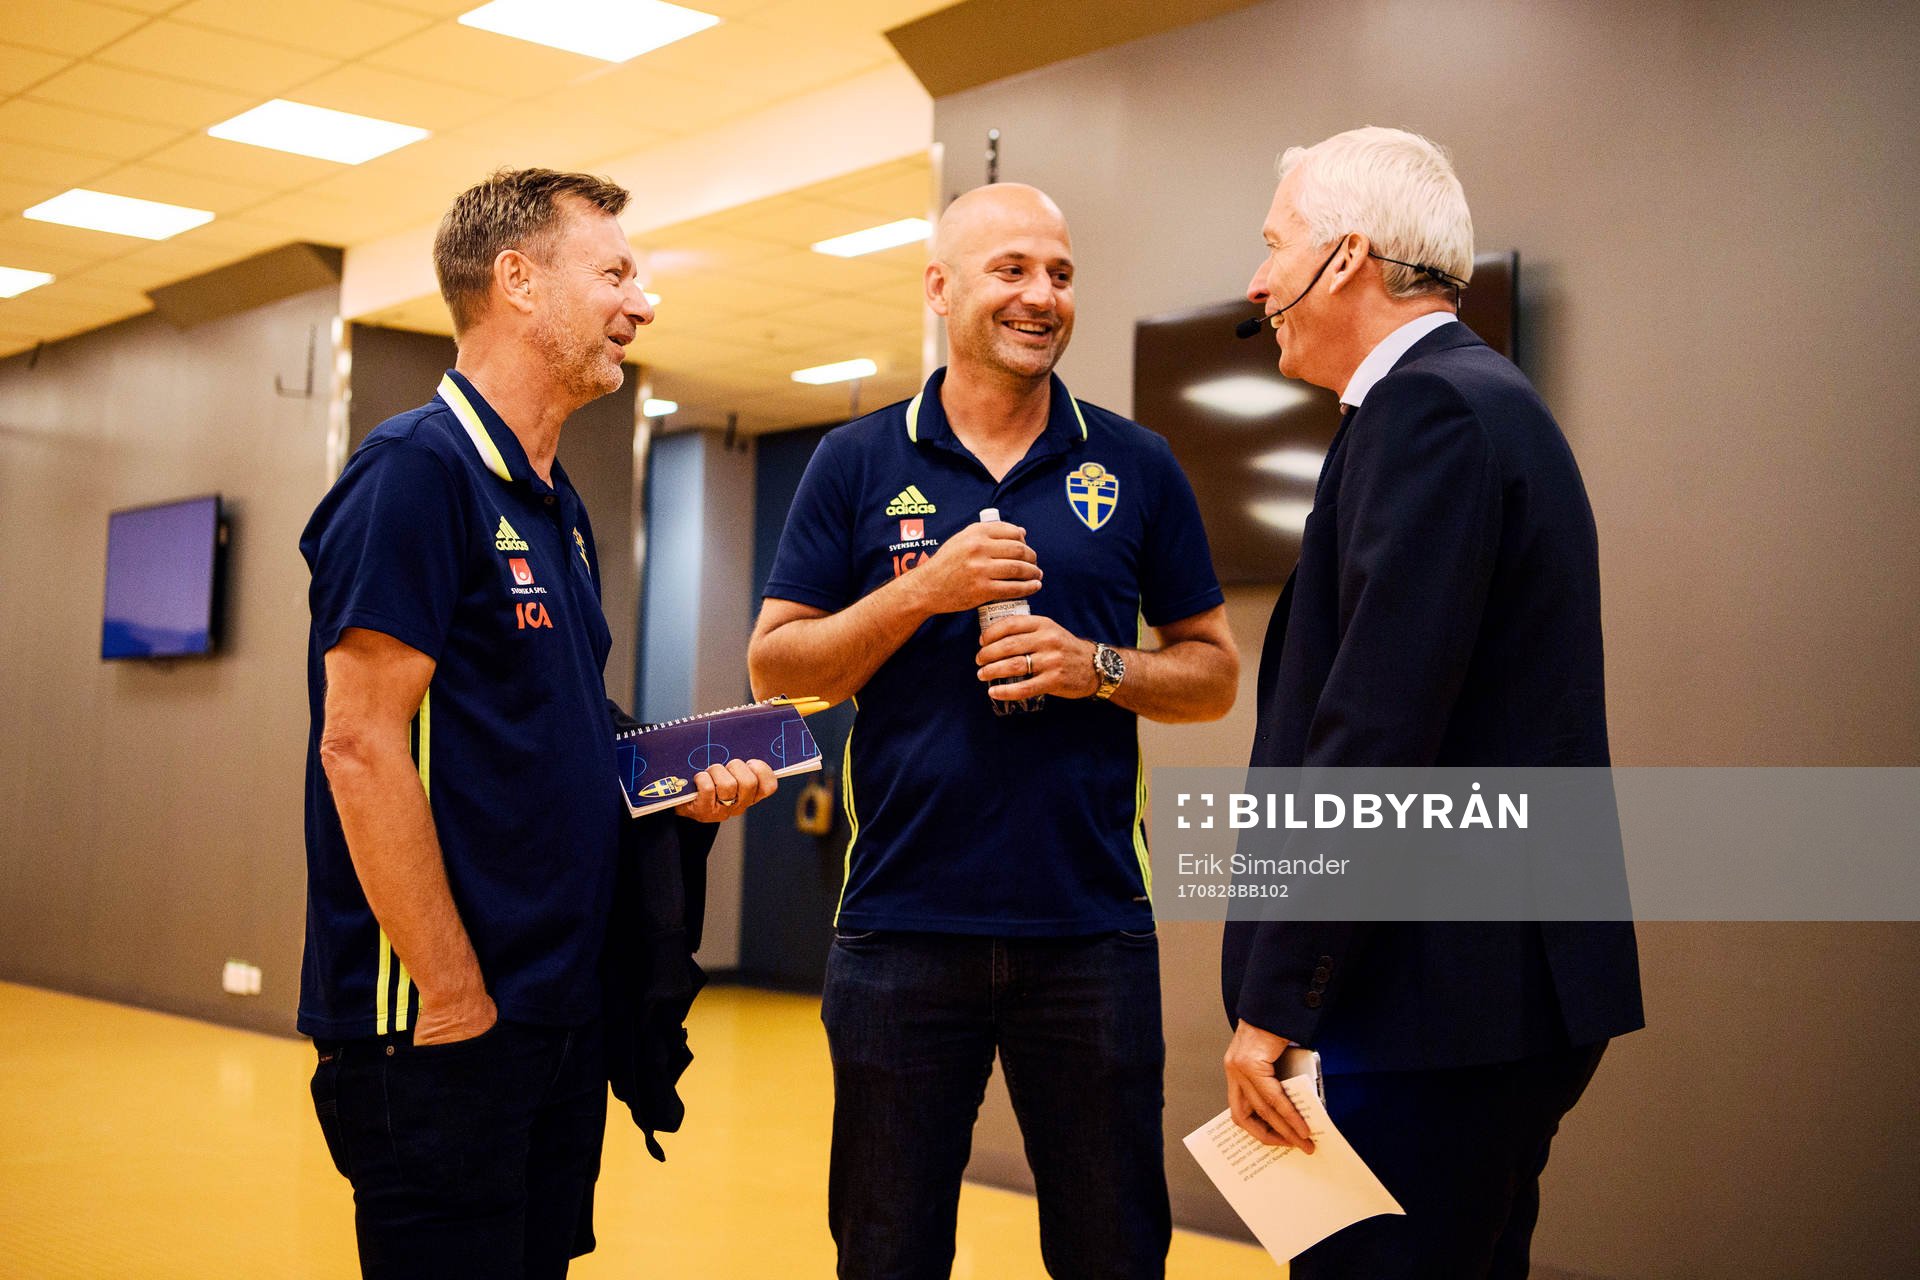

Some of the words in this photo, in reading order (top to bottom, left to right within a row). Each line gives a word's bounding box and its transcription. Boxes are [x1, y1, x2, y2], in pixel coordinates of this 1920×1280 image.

[886, 502, 937, 516] adidas
[495, 540, 529, 551] adidas
[889, 541, 920, 551] SVENSKA
[921, 539, 939, 547] SPEL
[516, 602, 554, 629] ICA
